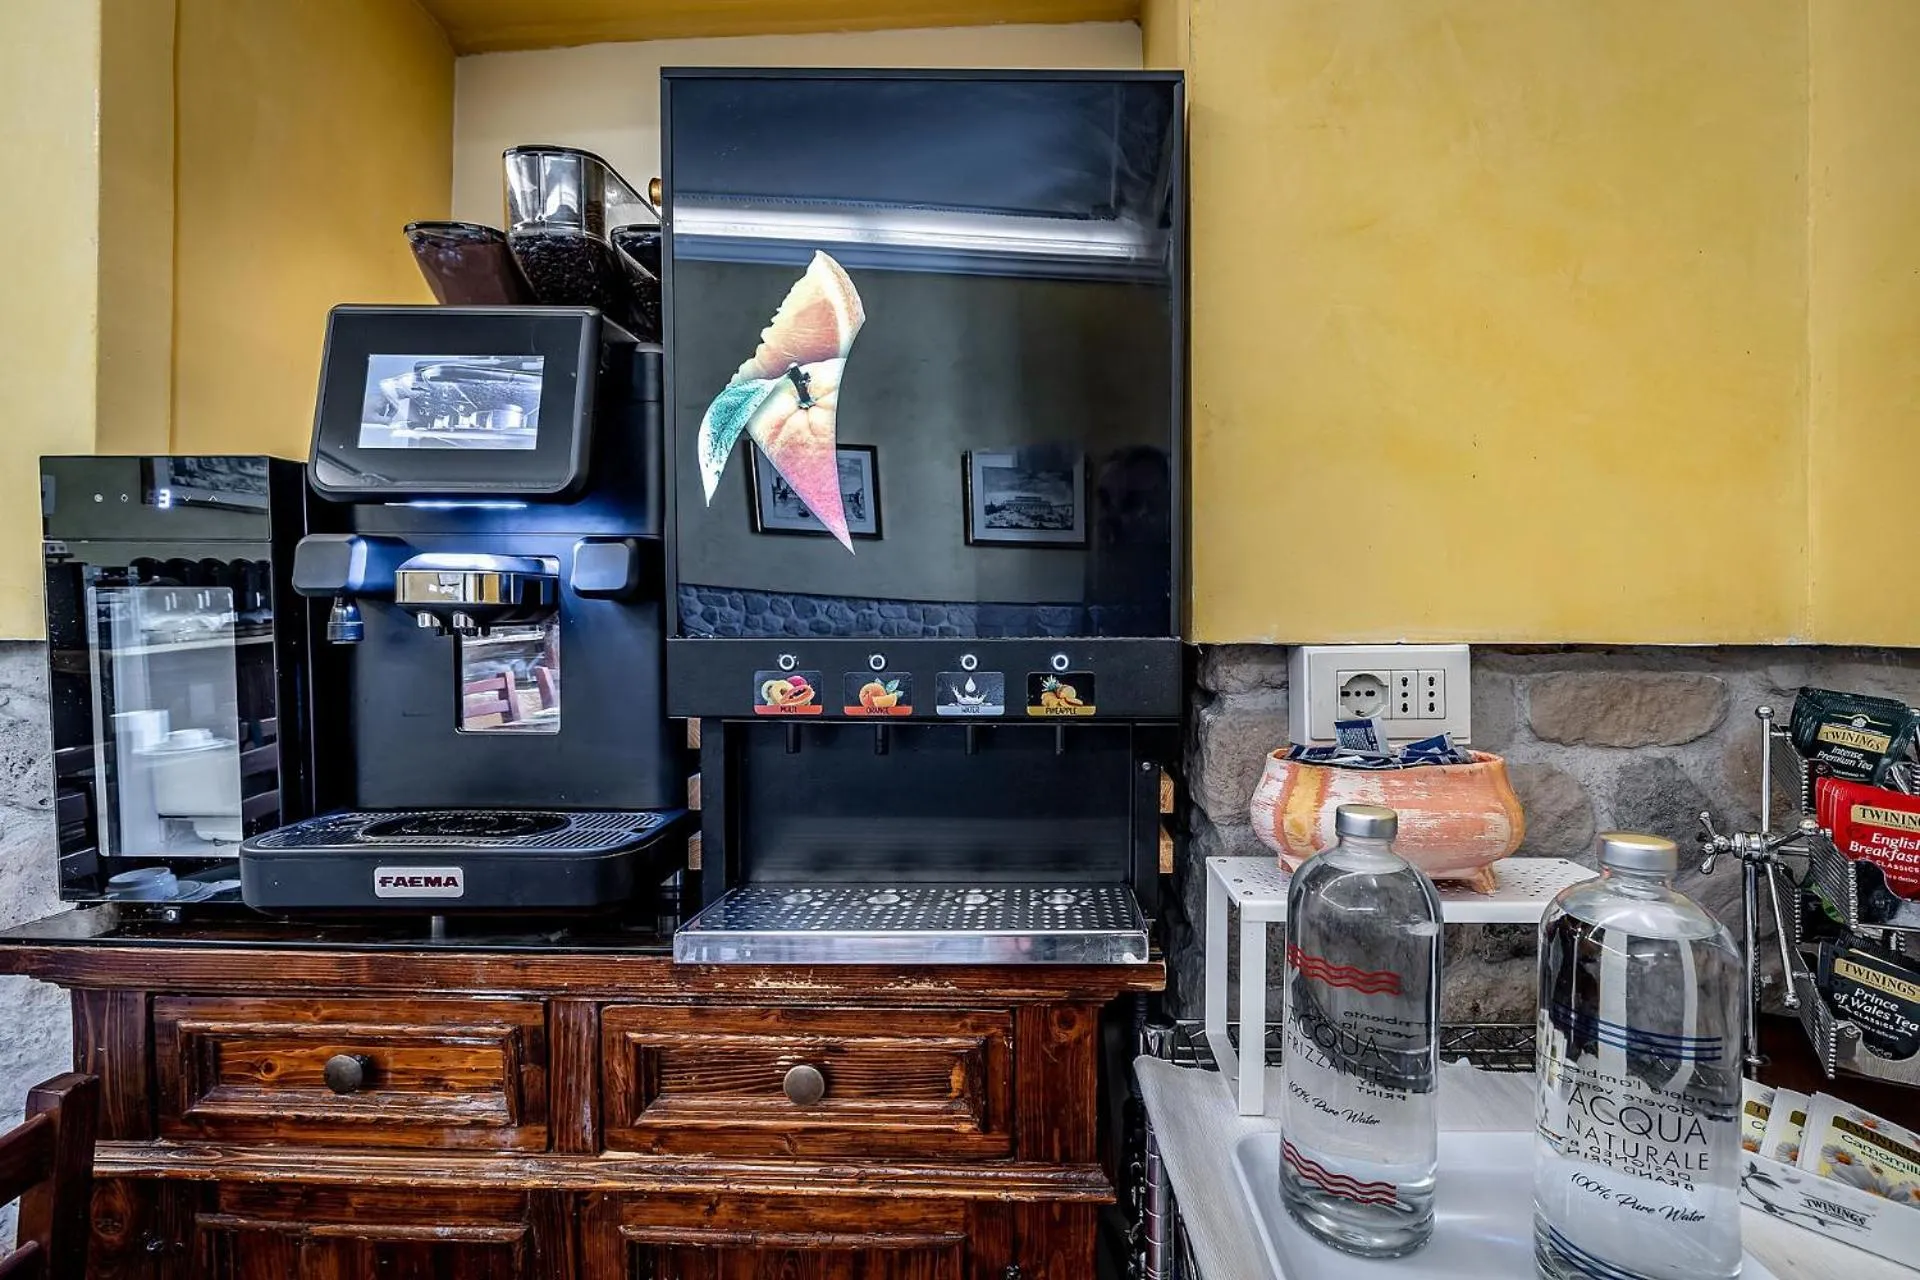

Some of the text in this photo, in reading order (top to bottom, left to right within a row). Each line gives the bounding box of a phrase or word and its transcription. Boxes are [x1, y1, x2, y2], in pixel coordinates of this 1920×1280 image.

[866, 707, 889, 715] ORANGE
[1046, 707, 1077, 715] PINEAPPLE
[1823, 731, 1881, 751] TWININGS
[1832, 746, 1864, 760] Intense
[1817, 751, 1874, 771] Premium Tea
[1860, 807, 1920, 827] TWININ
[1849, 840, 1920, 863] Breakfast
[379, 876, 459, 888] FAEMA
[1843, 963, 1917, 997] TWININGS
[1833, 993, 1849, 1004] of
[1851, 996, 1892, 1021] Wales
[1894, 1013, 1920, 1032] Tea
[1854, 987, 1899, 1012] Prince
[1288, 1005, 1382, 1059] ACQUA
[1287, 1031, 1384, 1081] FRIZZANTE
[1312, 1097, 1340, 1117] Pure
[1341, 1108, 1381, 1126] Water
[1567, 1086, 1707, 1145] ACQUA
[1567, 1114, 1710, 1171] NATURALE
[1841, 1134, 1920, 1176] Camomill
[1570, 1172, 1706, 1223] 100% Pure Water
[1805, 1199, 1867, 1226] TWININGS
